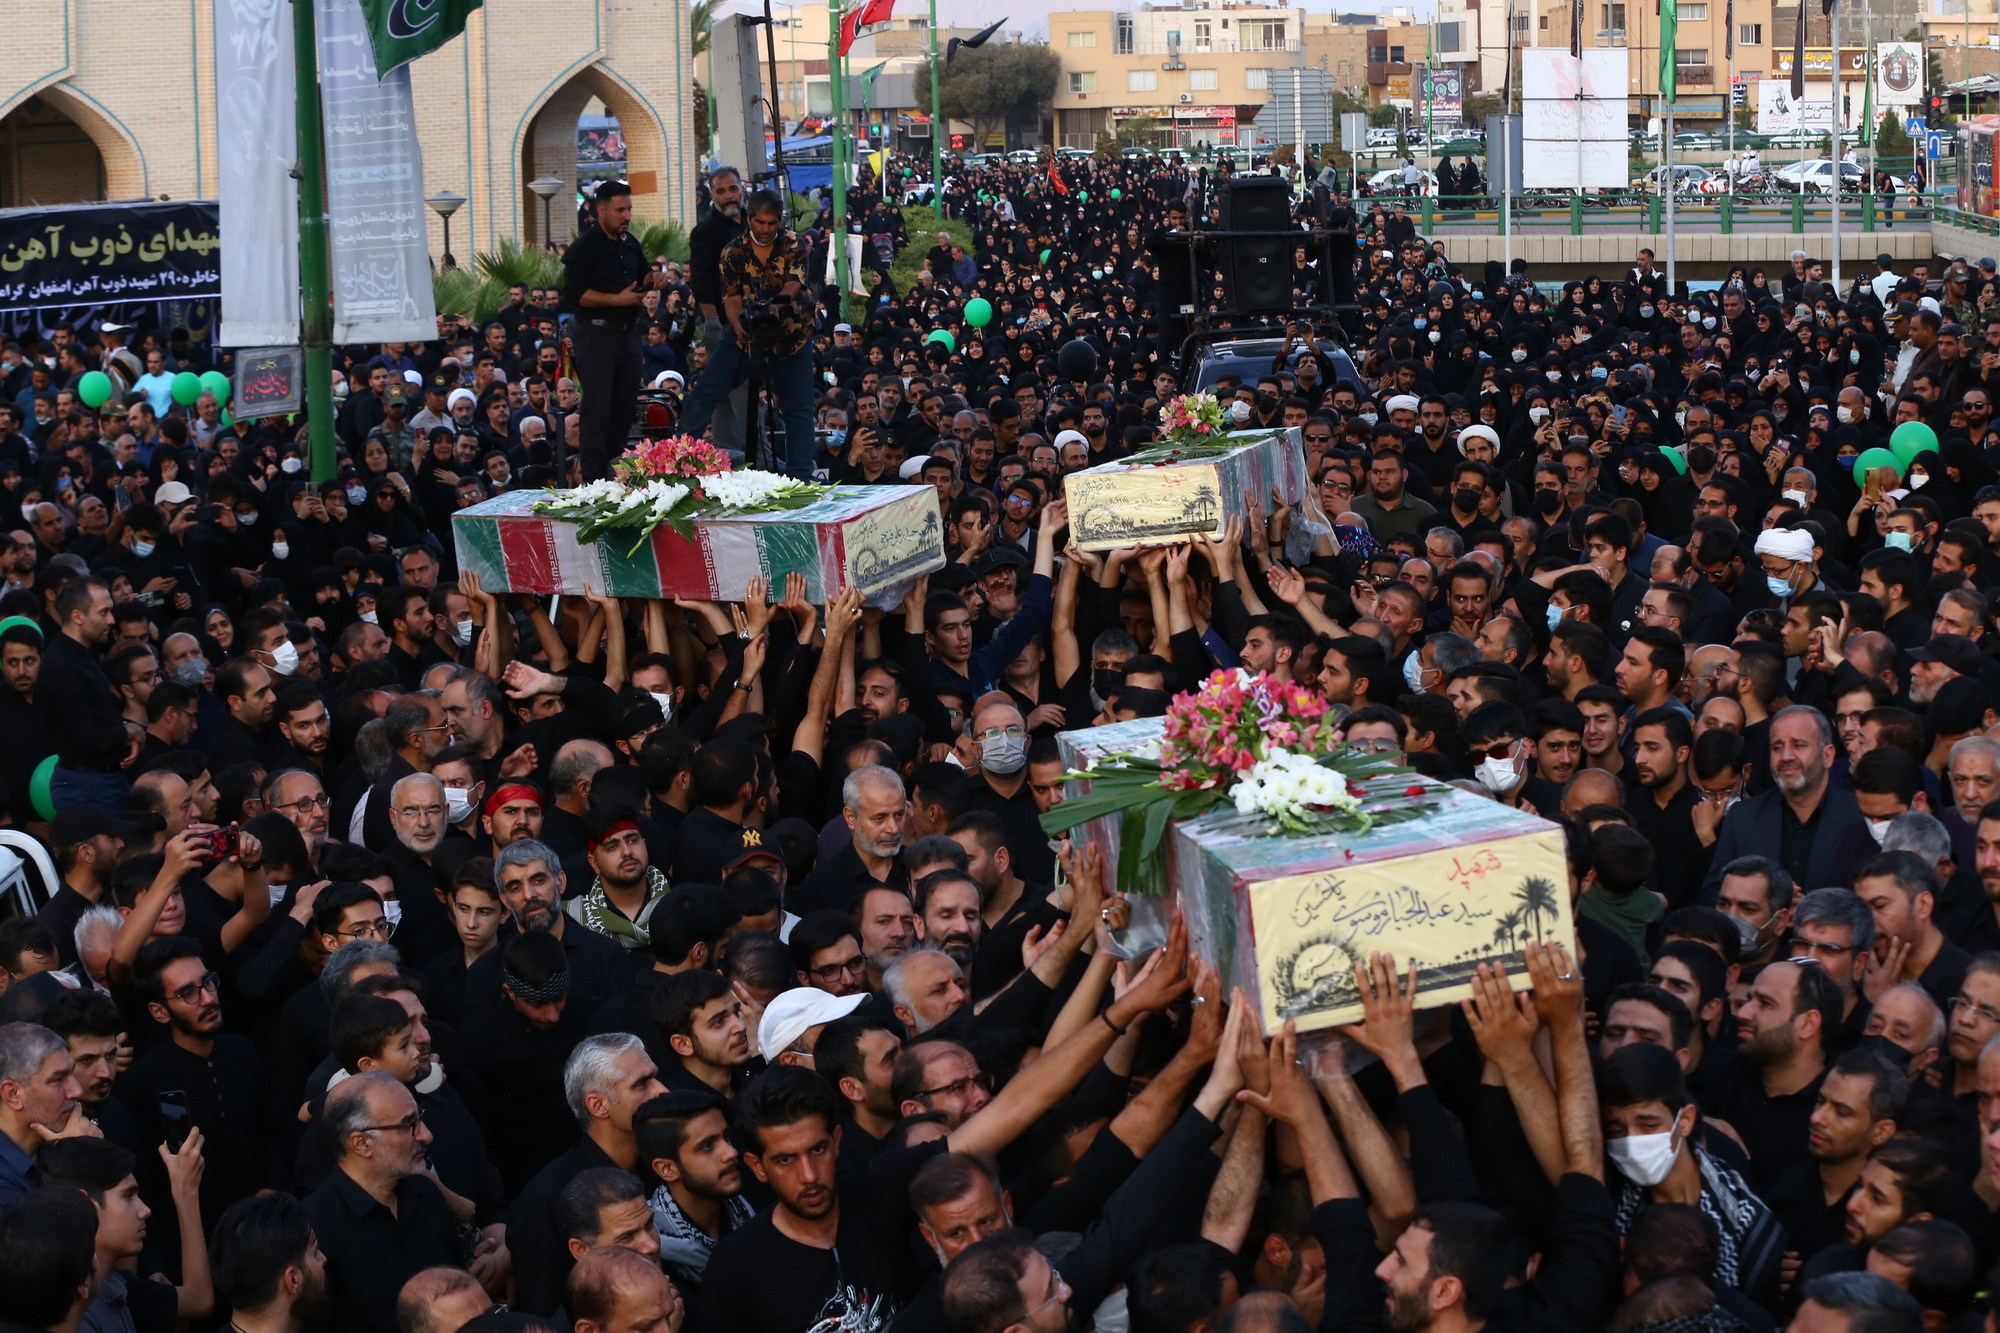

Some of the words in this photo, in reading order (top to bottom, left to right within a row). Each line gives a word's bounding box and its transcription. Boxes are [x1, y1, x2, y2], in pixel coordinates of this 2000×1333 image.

[1, 224, 65, 272] آهن
[70, 223, 133, 266] ذوب
[29, 279, 72, 299] اصفهان
[72, 275, 100, 296] آهن
[101, 274, 127, 293] ذوب
[129, 273, 158, 290] شهید
[1161, 472, 1188, 488] شهید
[741, 829, 763, 848] NY
[1446, 848, 1502, 891] شهید
[1333, 898, 1389, 943] موسوی
[1454, 895, 1493, 926] سید
